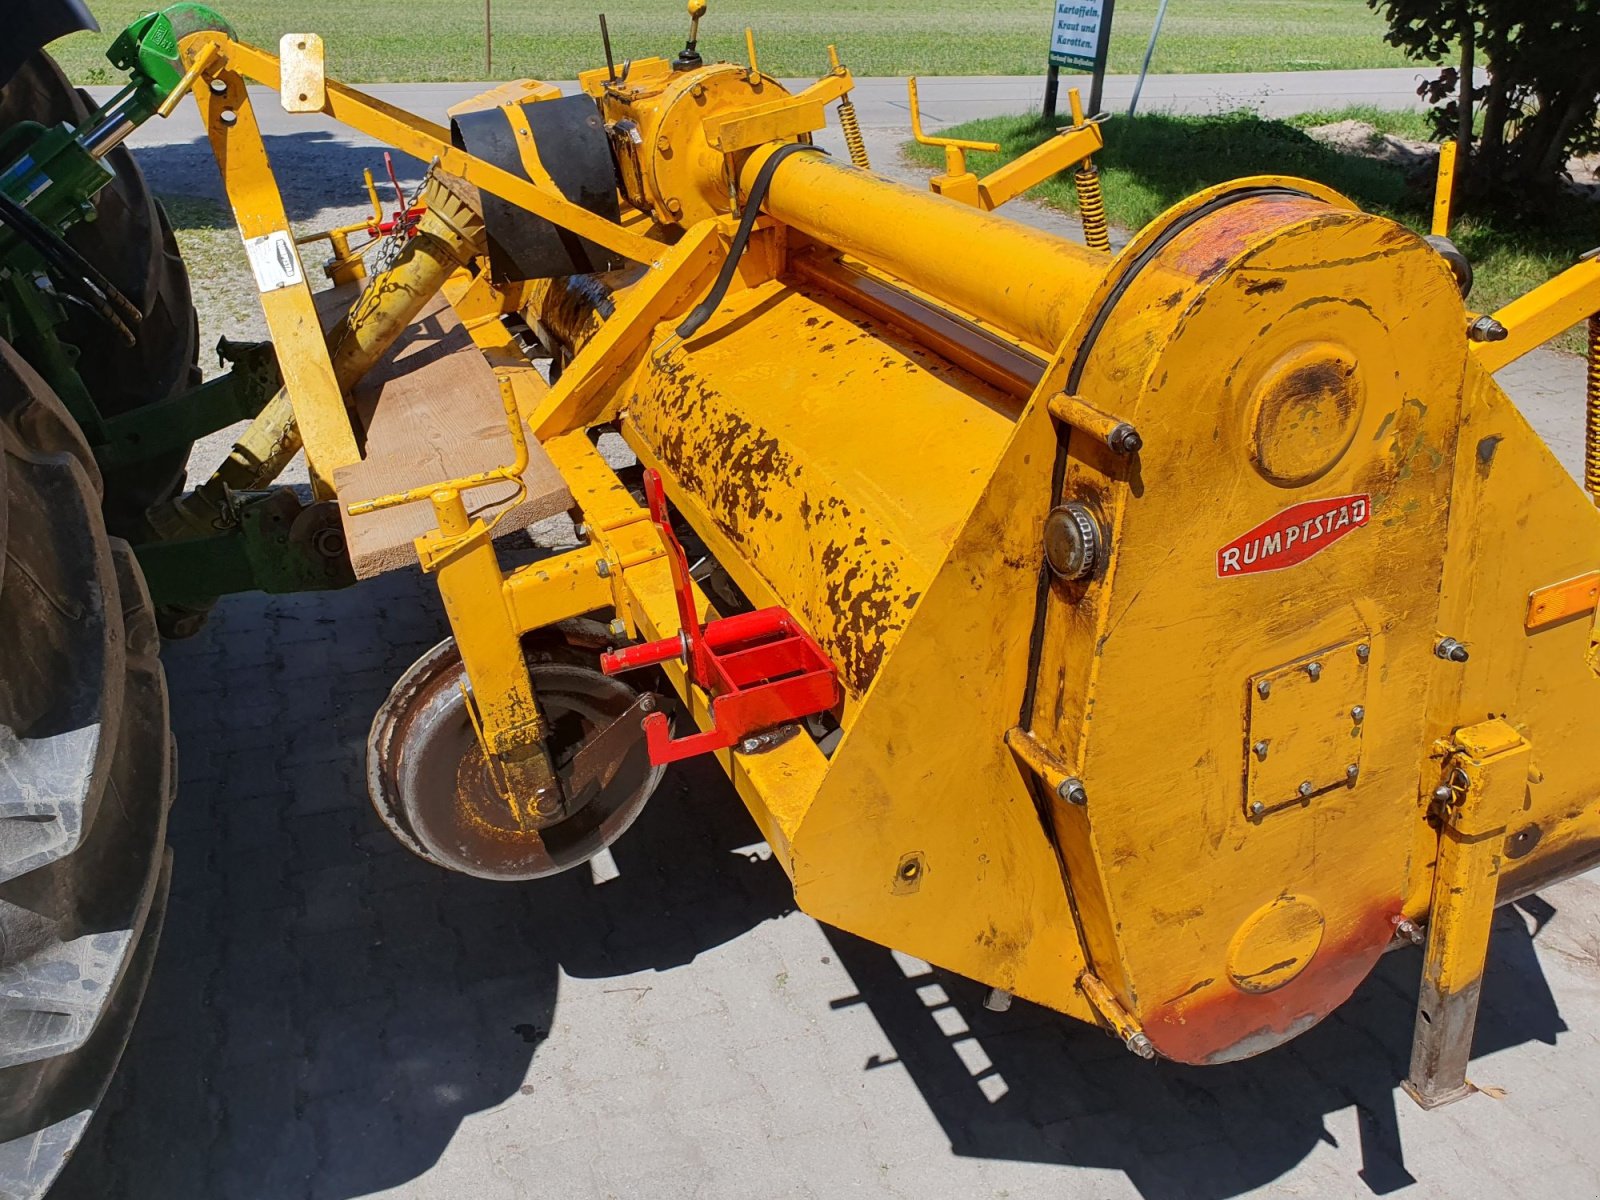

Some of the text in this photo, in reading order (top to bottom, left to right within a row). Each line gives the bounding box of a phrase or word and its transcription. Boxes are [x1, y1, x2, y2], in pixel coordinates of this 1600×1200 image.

[1058, 4, 1100, 18] Kartoffeln,
[1058, 20, 1096, 33] Kraut und
[1057, 35, 1092, 48] Karotten.
[1222, 499, 1366, 572] RUMPTSTAD
